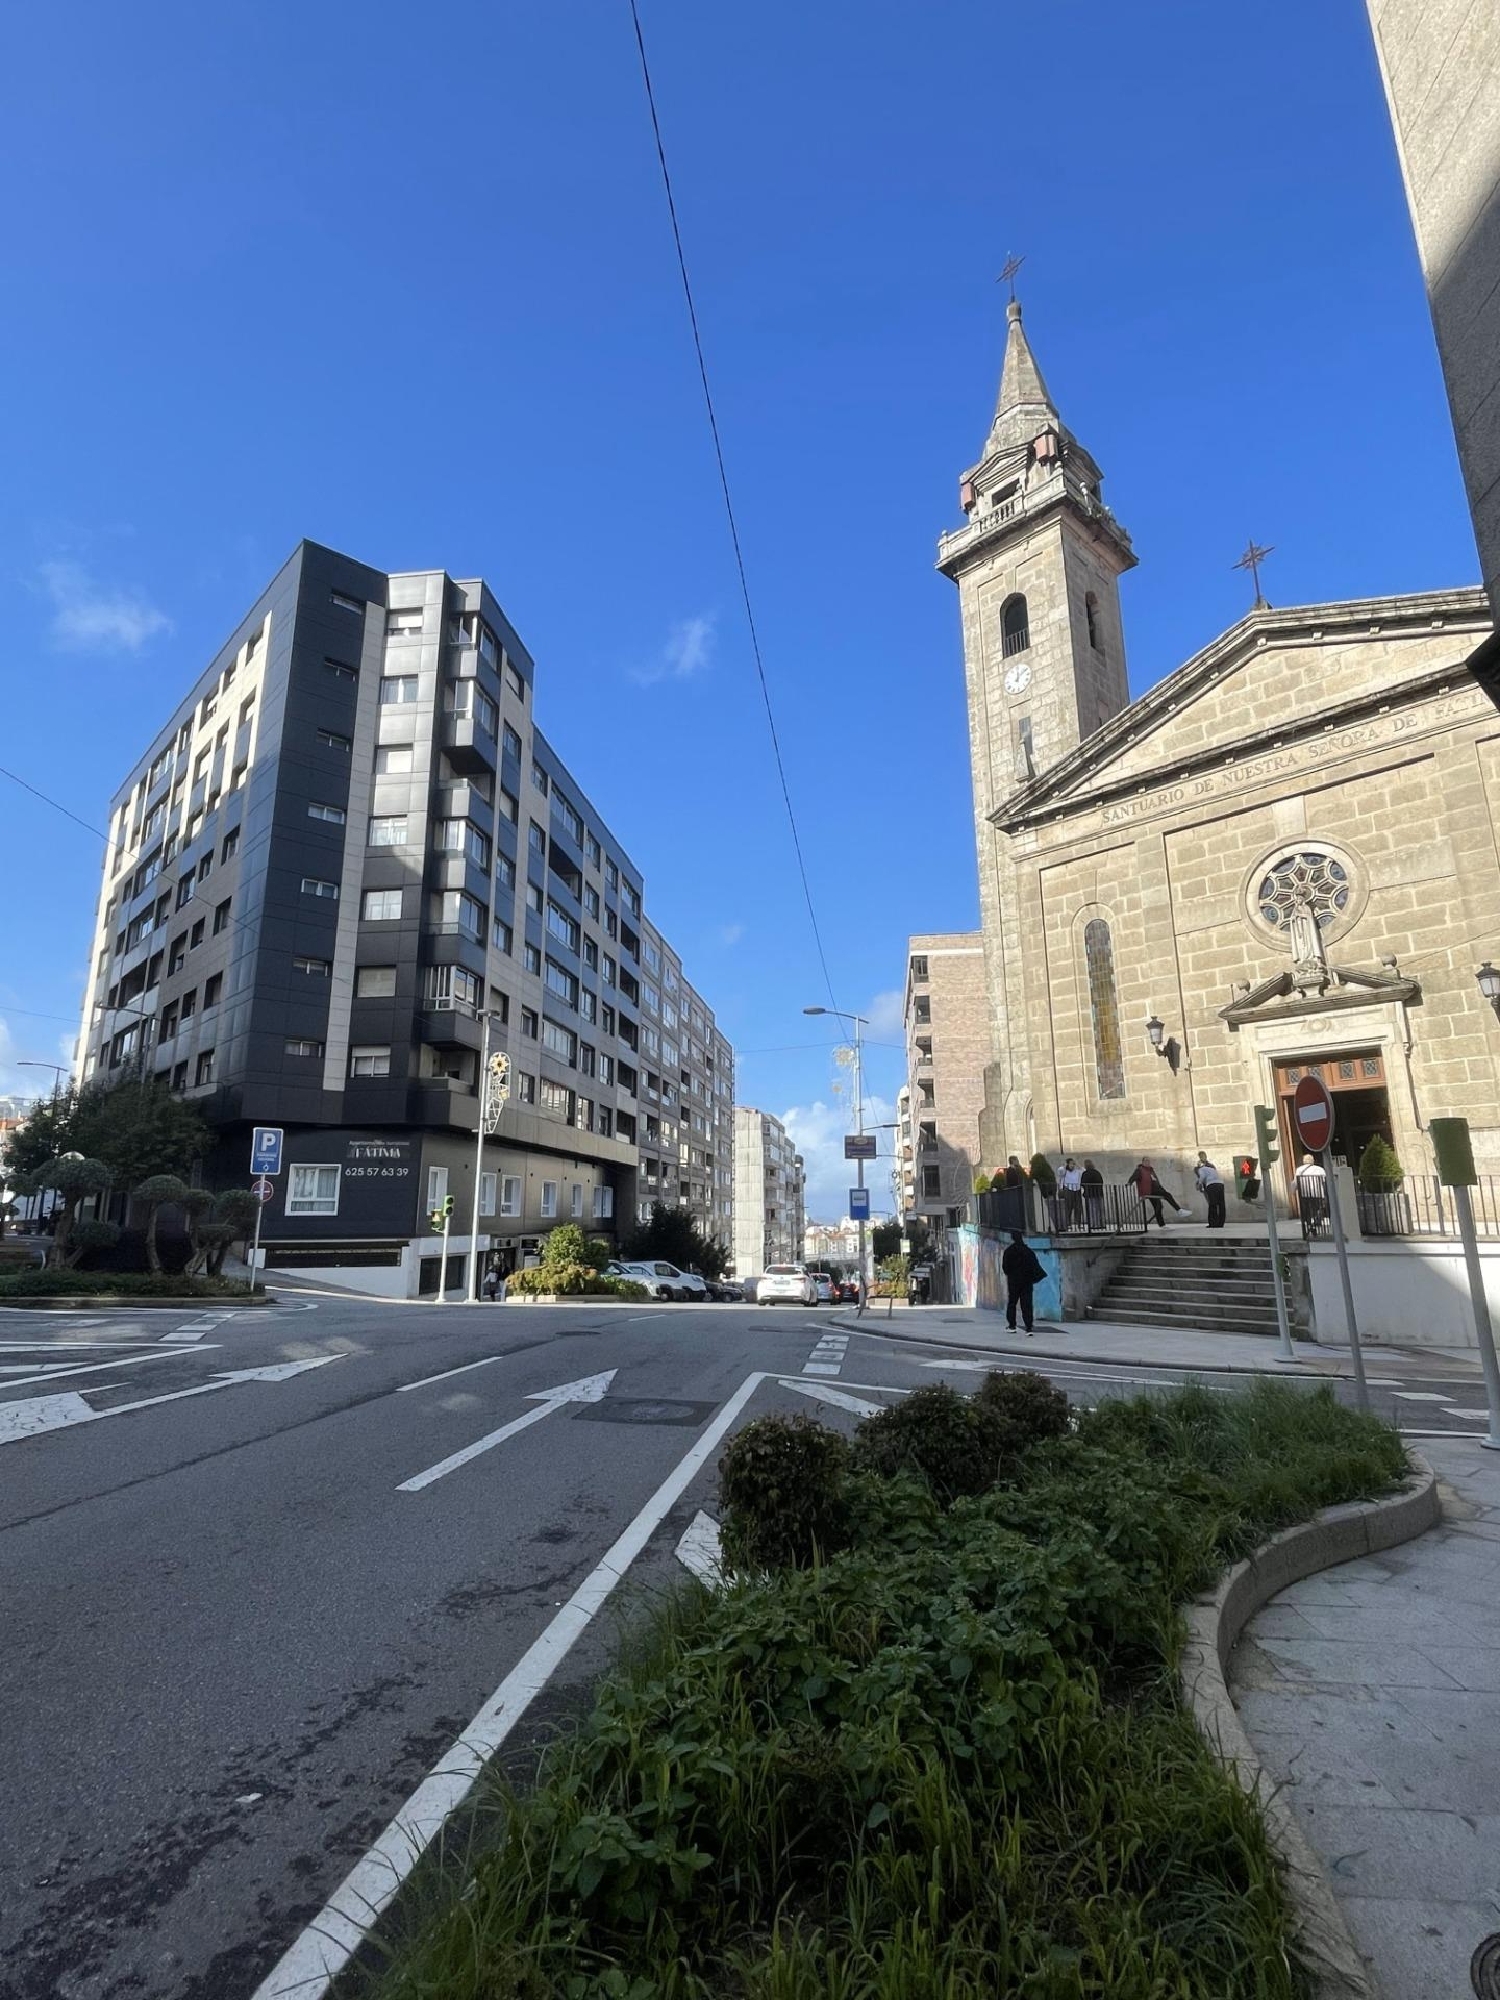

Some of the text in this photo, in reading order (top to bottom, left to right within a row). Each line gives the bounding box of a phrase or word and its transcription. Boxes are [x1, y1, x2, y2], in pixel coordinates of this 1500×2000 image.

[1102, 788, 1184, 824] SANTUARIO
[1194, 778, 1214, 796] DE
[1221, 753, 1298, 787] NUESTRA
[1308, 726, 1380, 759] SEÑORA
[1392, 713, 1418, 733] DE
[261, 1132, 276, 1151] P
[345, 1167, 409, 1176] 625 57 63 39
